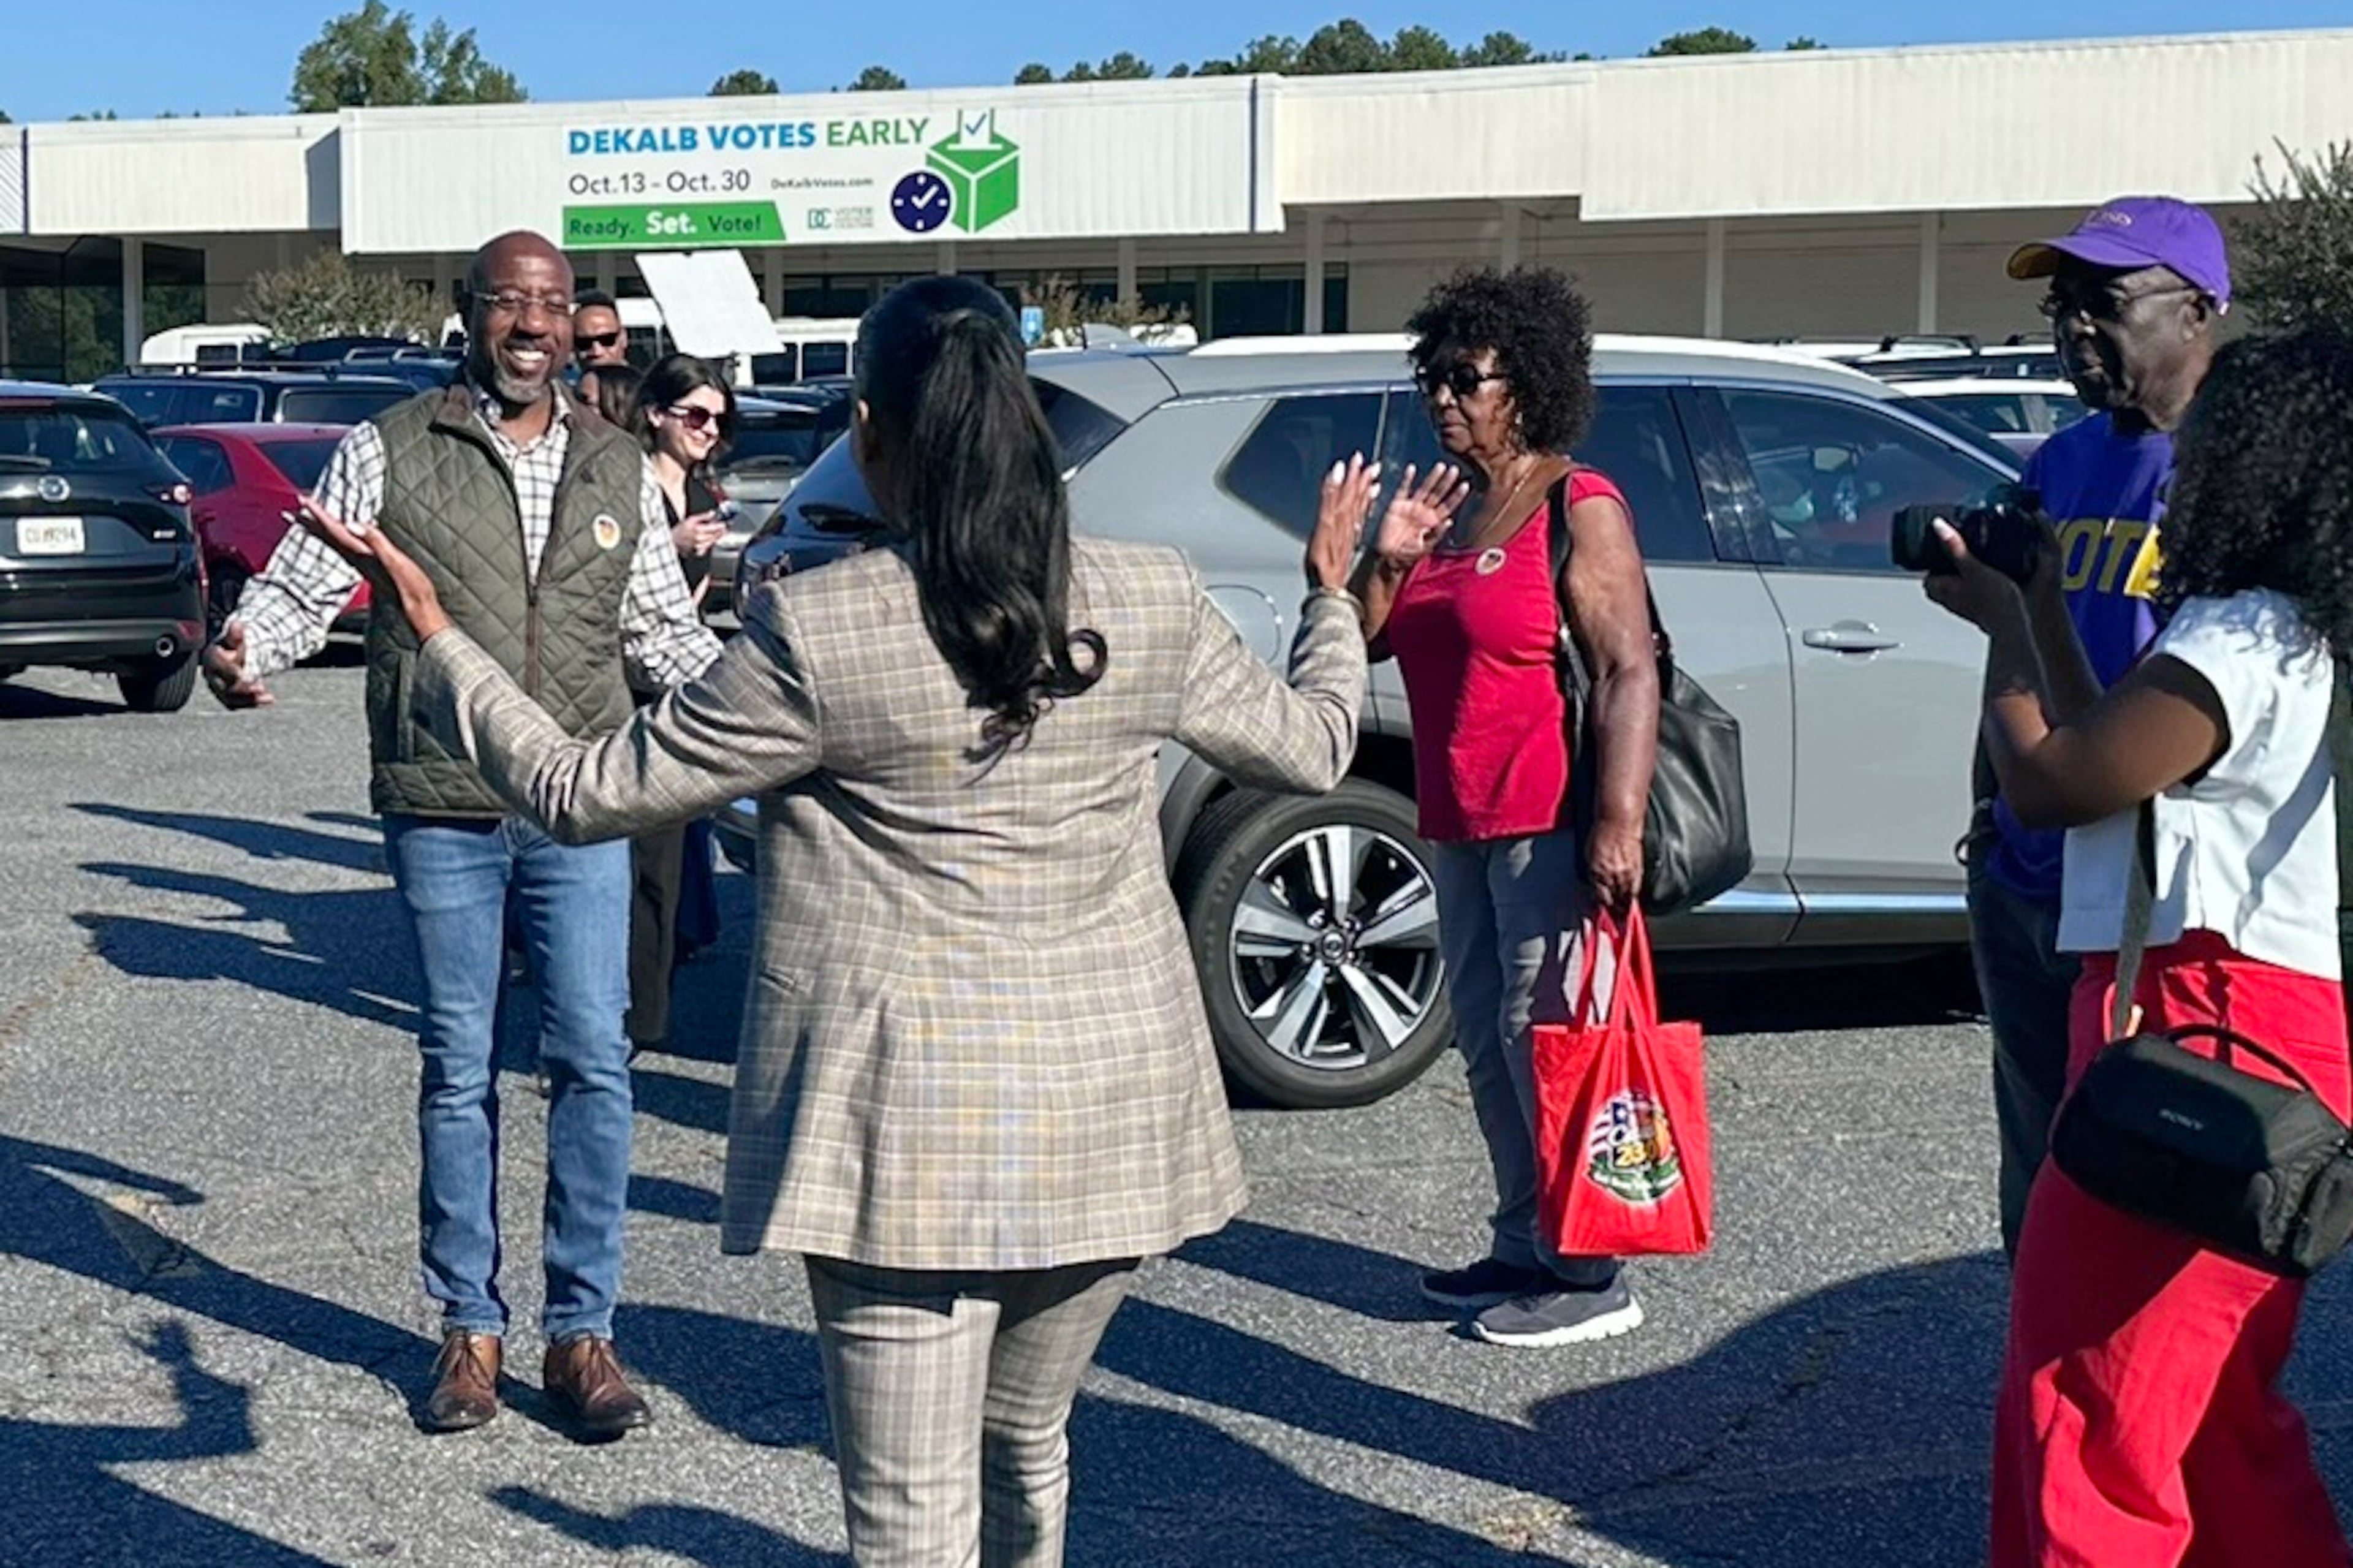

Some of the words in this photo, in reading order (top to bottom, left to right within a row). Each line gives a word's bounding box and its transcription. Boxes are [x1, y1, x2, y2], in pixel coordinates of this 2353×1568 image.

[569, 126, 699, 154] DEKALB
[707, 123, 816, 150] VOTES
[827, 118, 930, 146] EARLY
[667, 170, 716, 192] Oct.
[721, 169, 751, 191] 30
[771, 178, 874, 189] DeKalbVotes.com
[570, 218, 635, 238] Ready.
[646, 210, 698, 235] Set.
[708, 214, 761, 232] Vote!
